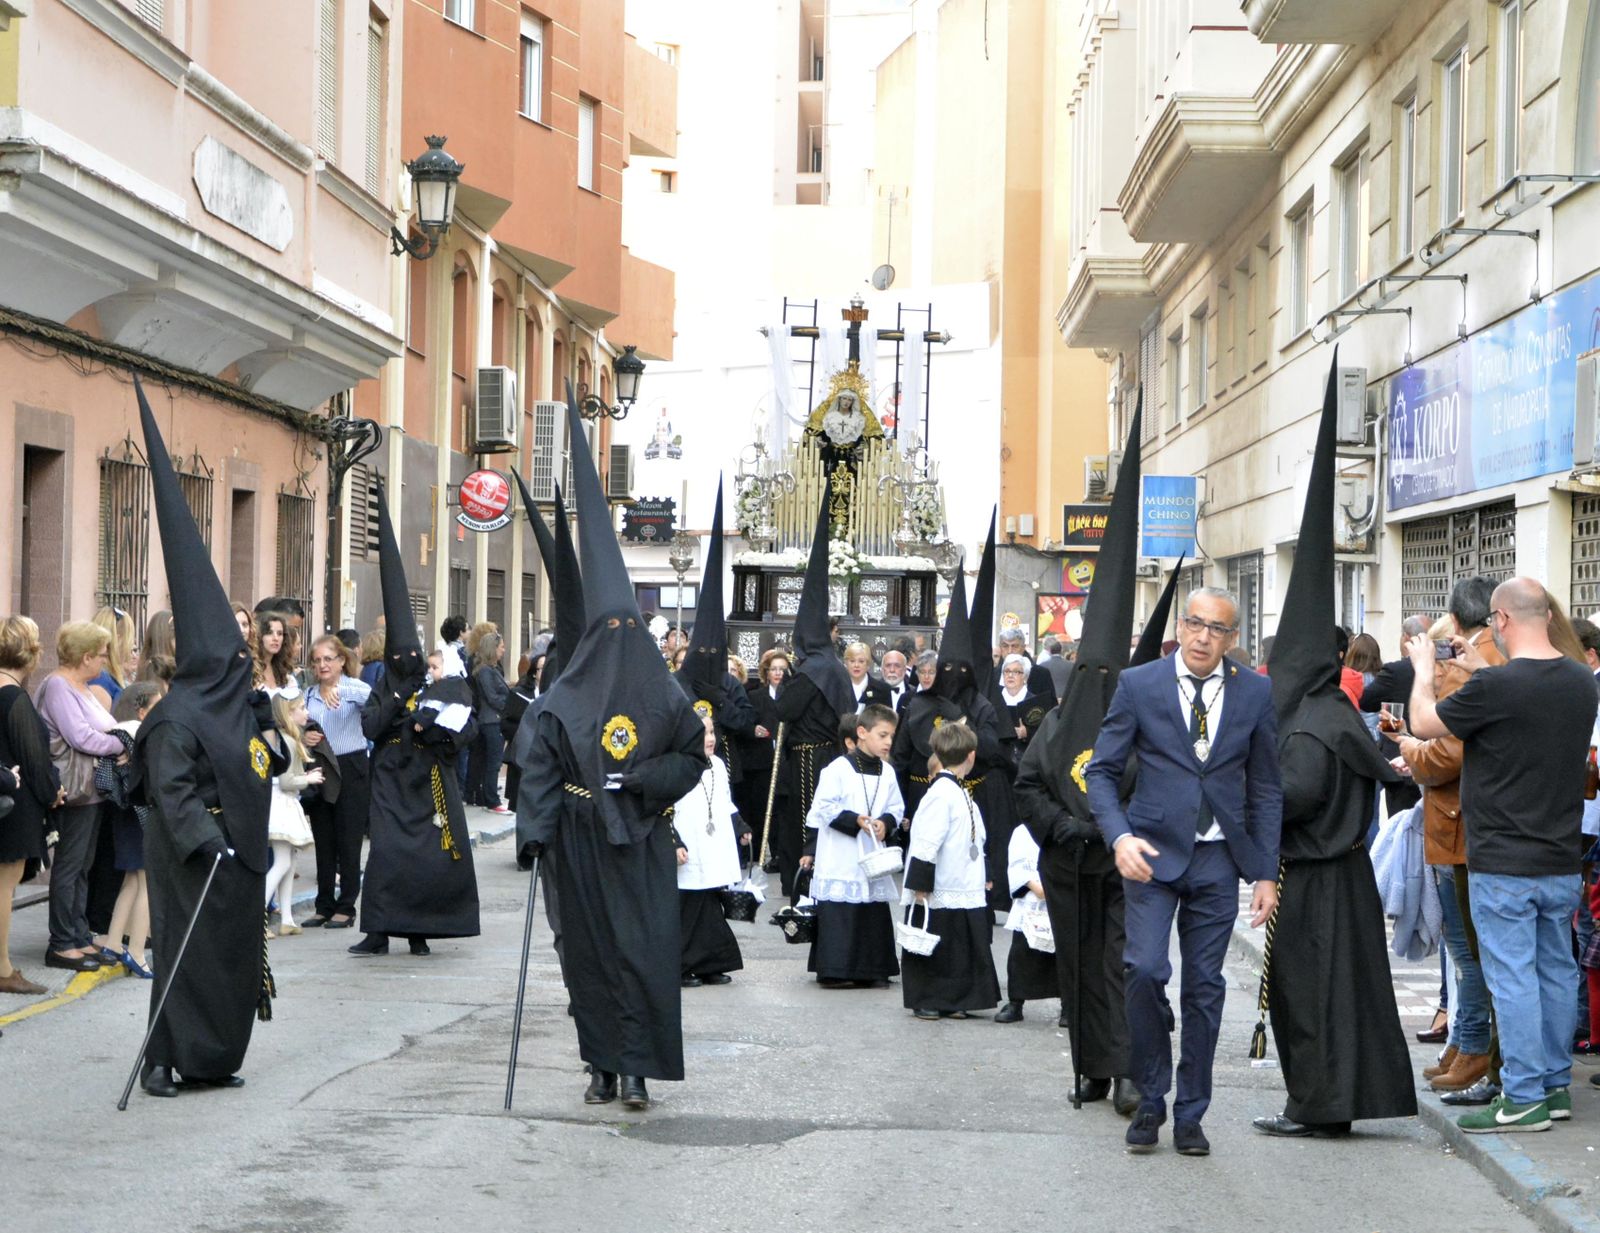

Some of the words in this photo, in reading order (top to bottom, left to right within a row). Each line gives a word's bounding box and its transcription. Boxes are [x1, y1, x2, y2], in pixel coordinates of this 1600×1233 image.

[1413, 391, 1460, 465] KORPO
[1144, 496, 1195, 506] MUNDO
[1148, 509, 1190, 520] CHINO
[460, 515, 480, 529] MESON
